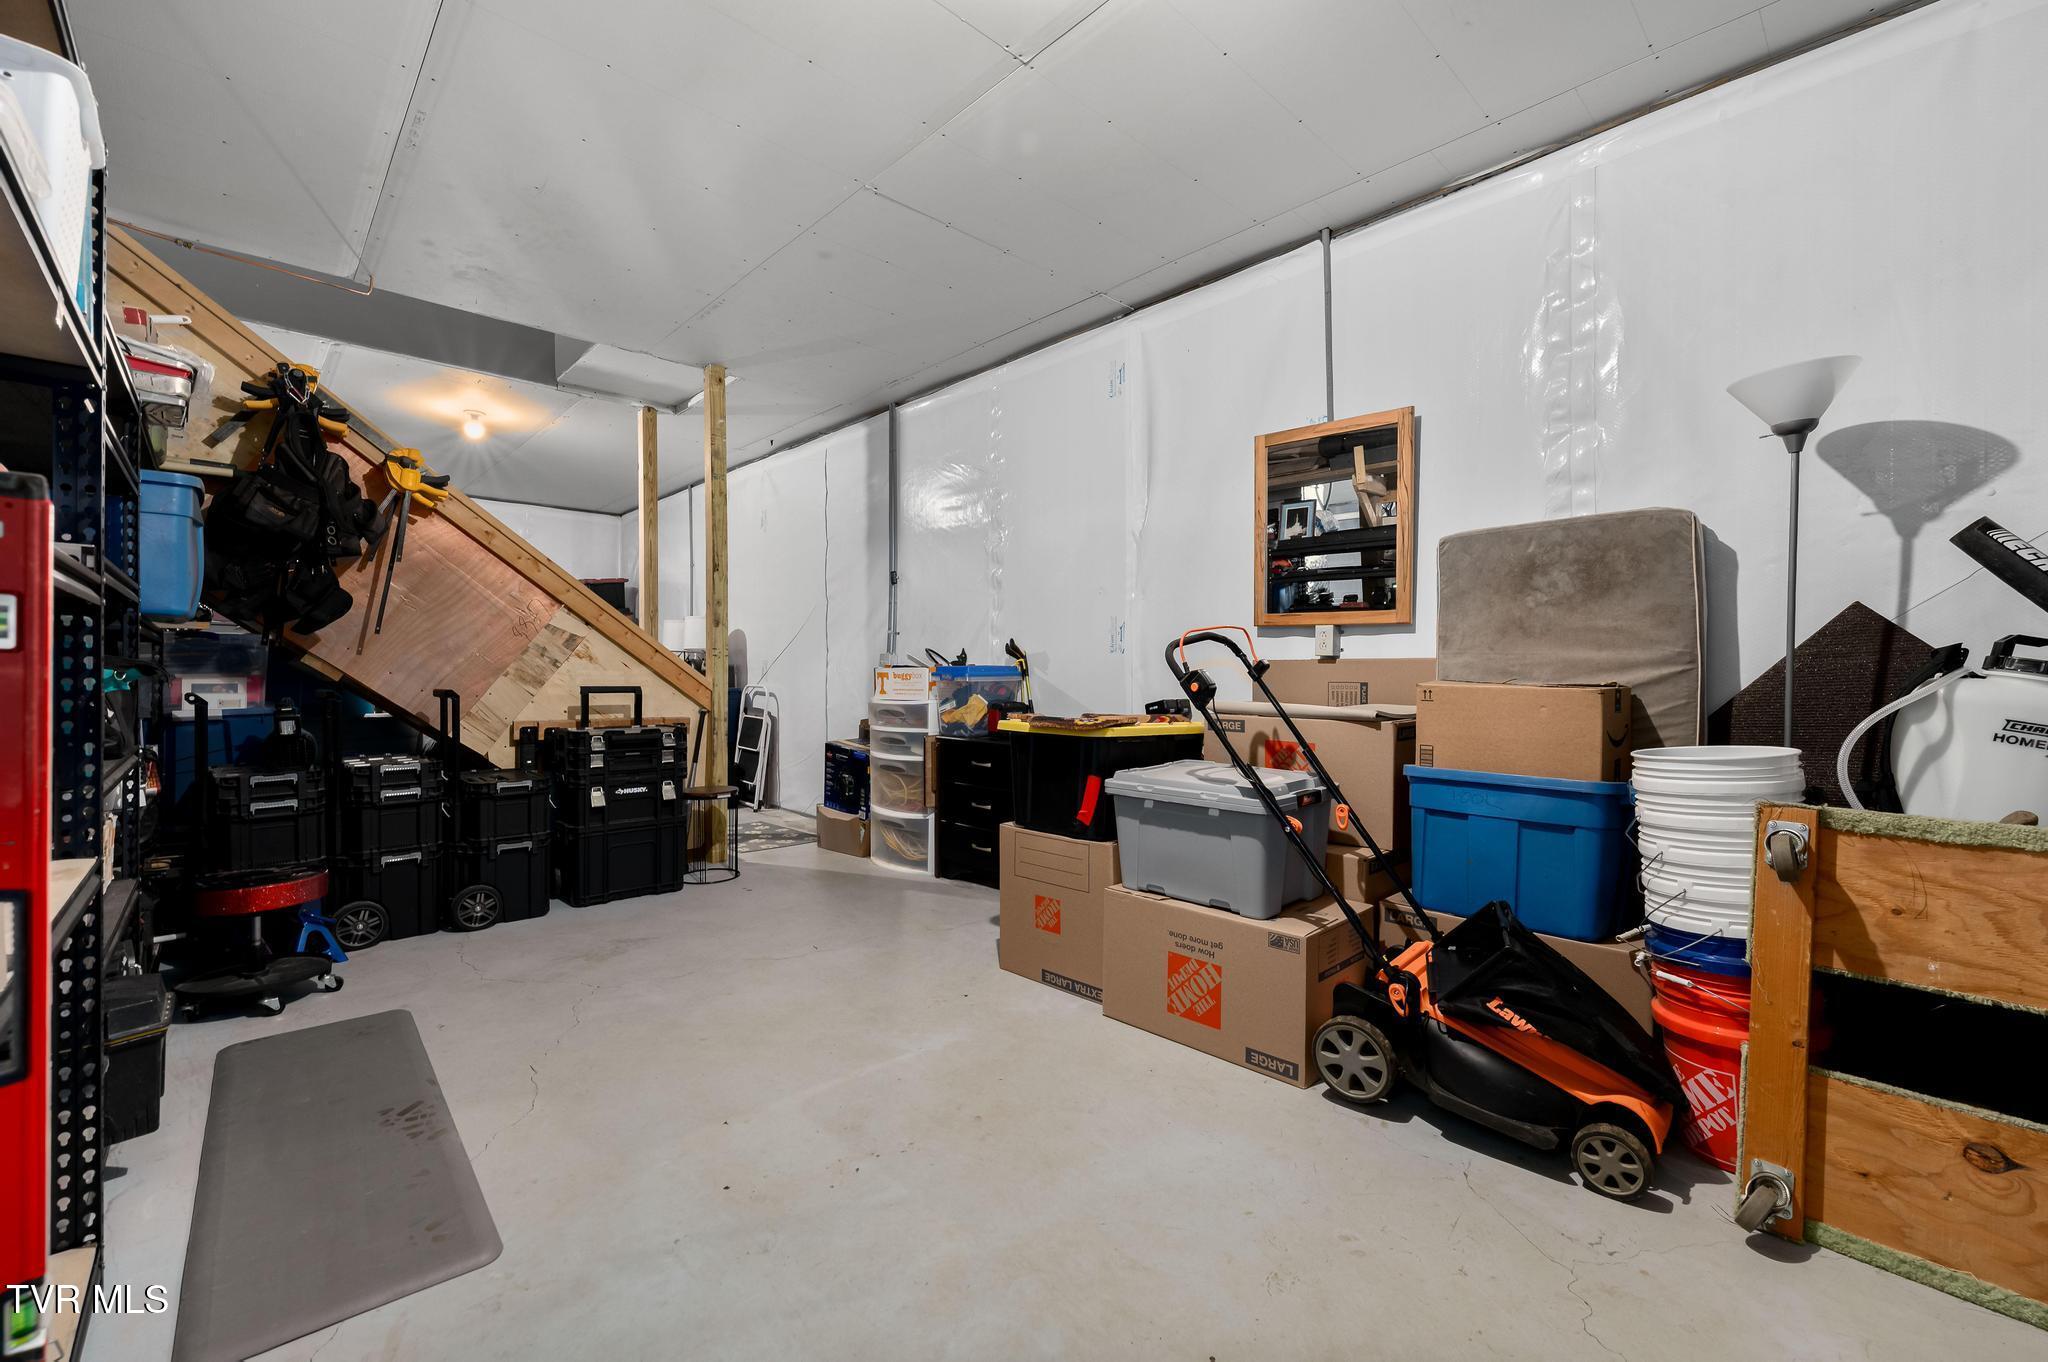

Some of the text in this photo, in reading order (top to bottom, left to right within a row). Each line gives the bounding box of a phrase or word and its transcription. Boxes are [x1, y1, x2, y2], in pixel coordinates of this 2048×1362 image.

[2010, 723, 2048, 735] CHA
[1993, 733, 2048, 750] HOME
[1389, 911, 1426, 928] LARG
[1189, 935, 1209, 945] more
[1210, 940, 1224, 950] get
[1174, 941, 1215, 959] How doers
[1044, 973, 1073, 990] LARGE
[1168, 963, 1222, 1017] HOME
[1250, 1052, 1294, 1077] LARGE
